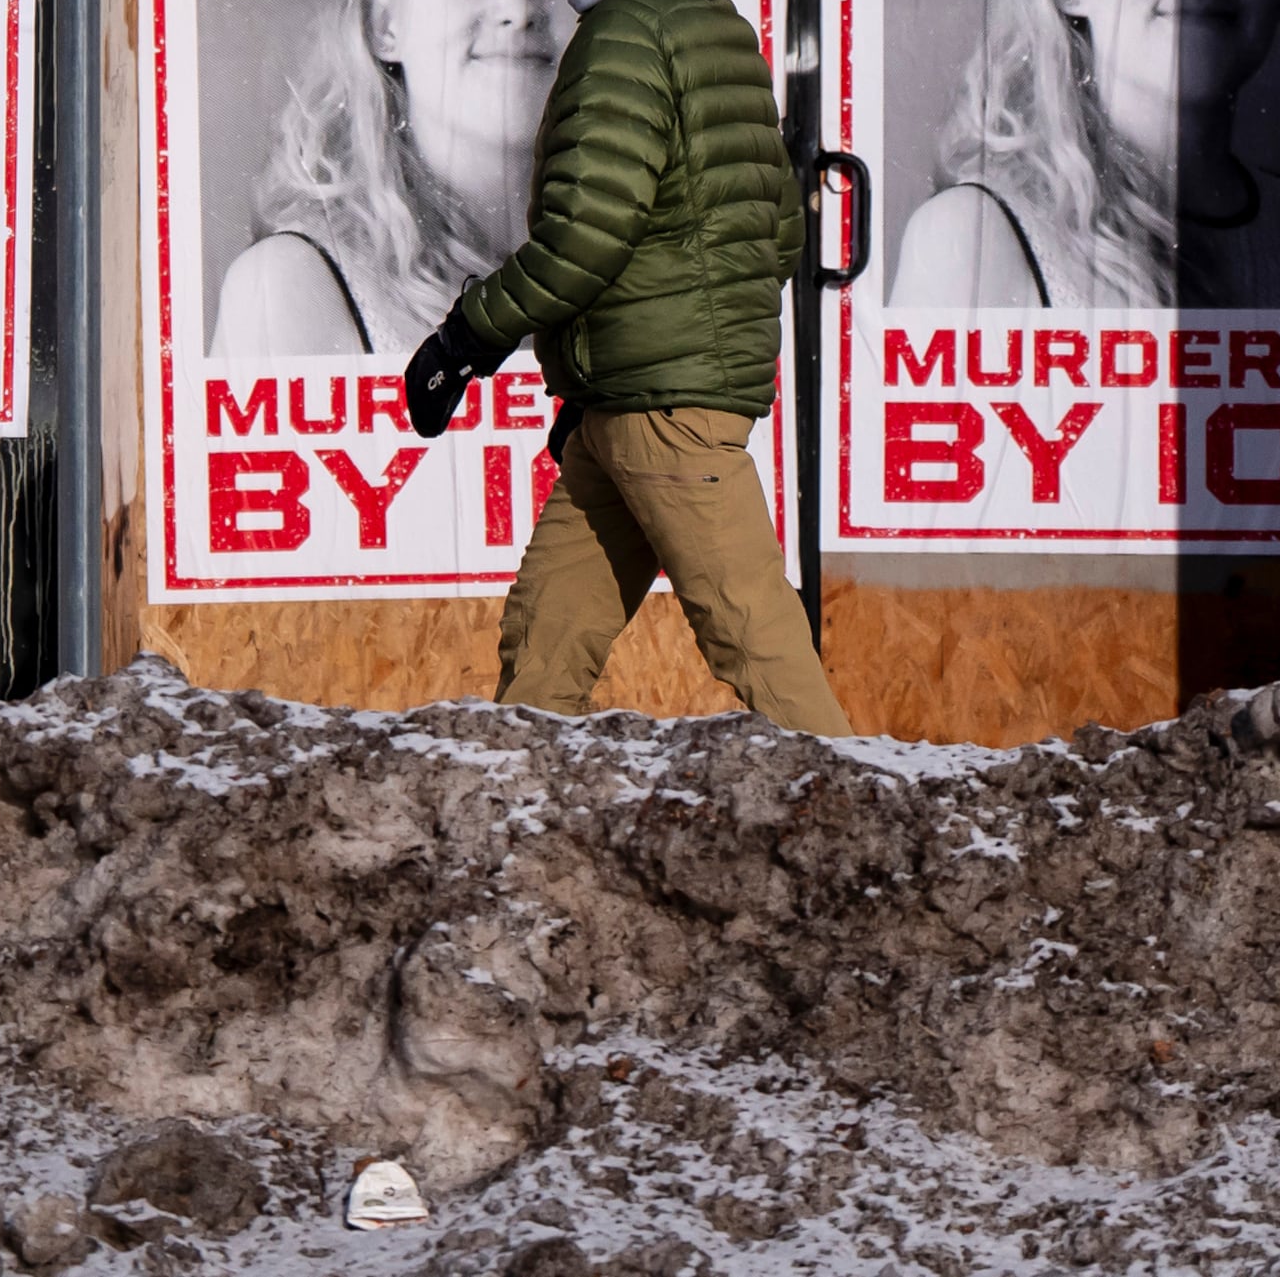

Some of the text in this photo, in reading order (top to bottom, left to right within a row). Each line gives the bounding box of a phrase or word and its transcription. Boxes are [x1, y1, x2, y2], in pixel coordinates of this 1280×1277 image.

[206, 372, 565, 436] MURDE
[428, 370, 445, 390] OR
[884, 402, 1103, 503] BY
[208, 447, 428, 553] BY
